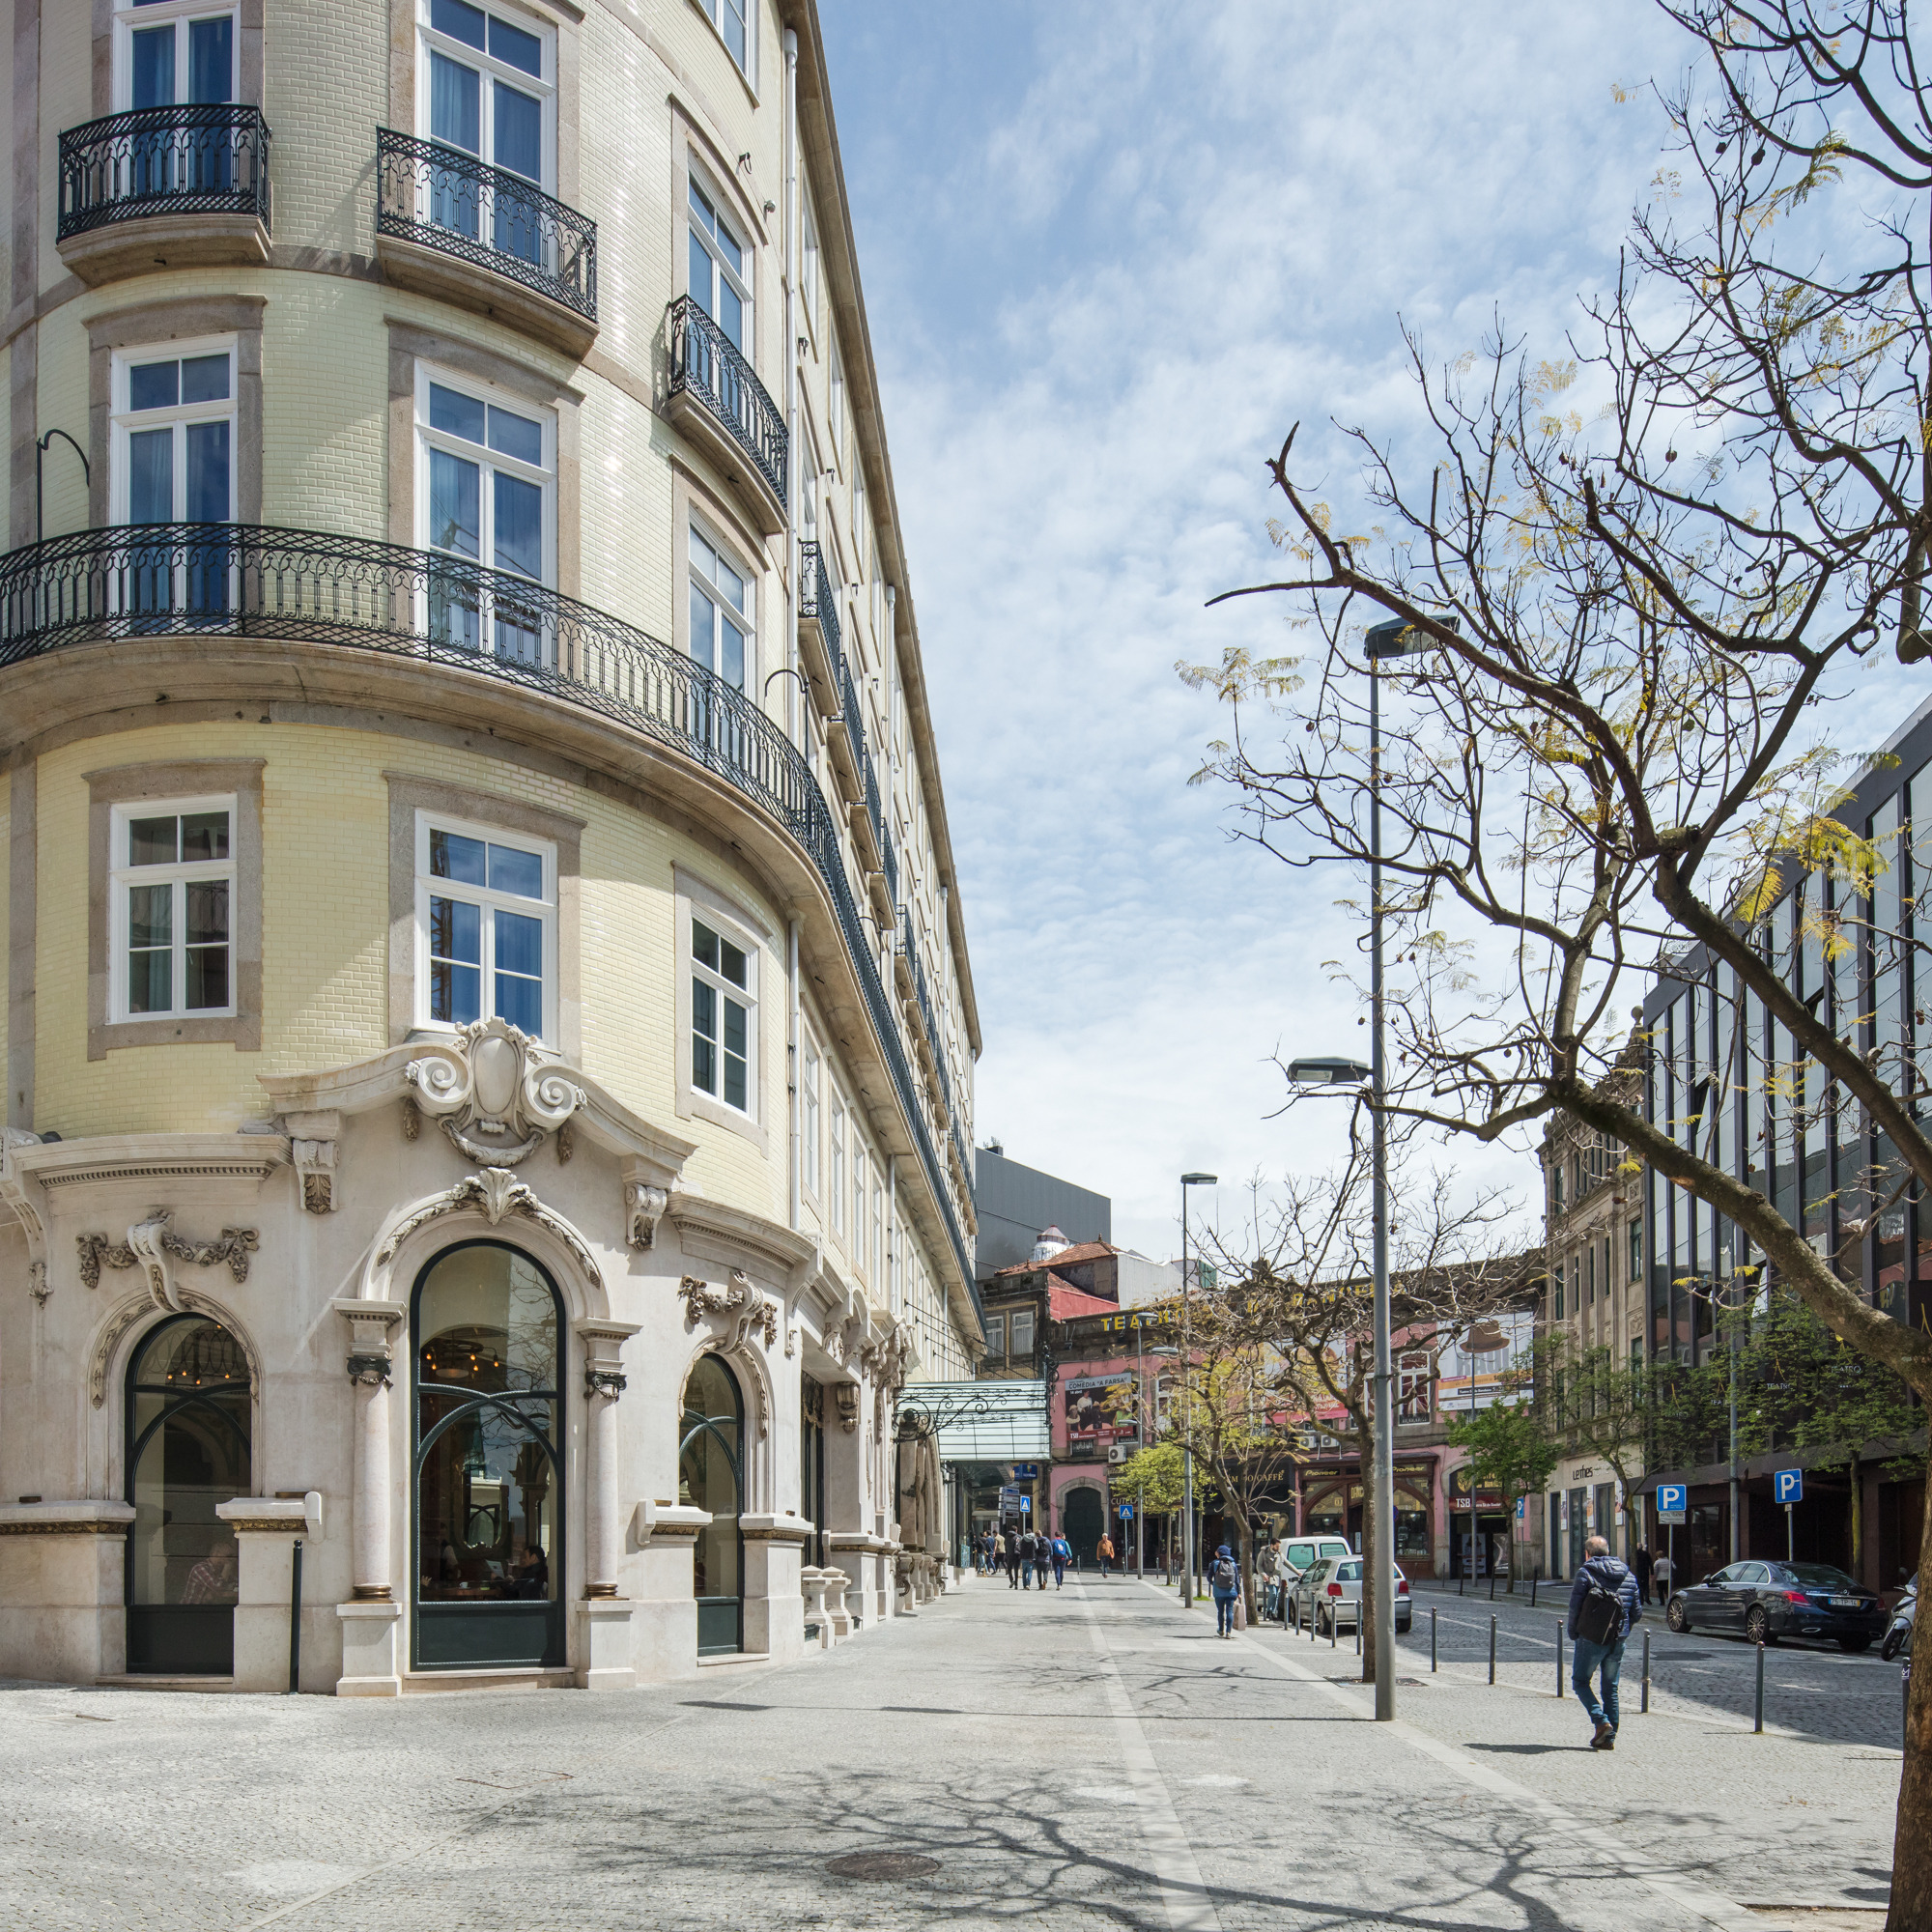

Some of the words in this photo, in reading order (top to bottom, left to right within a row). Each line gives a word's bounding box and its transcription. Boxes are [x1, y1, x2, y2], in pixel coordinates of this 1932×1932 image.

[1100, 1307, 1184, 1331] TEARO
[1781, 1473, 1795, 1500] P
[1456, 1497, 1471, 1508] TSB
[1662, 1488, 1680, 1509] P
